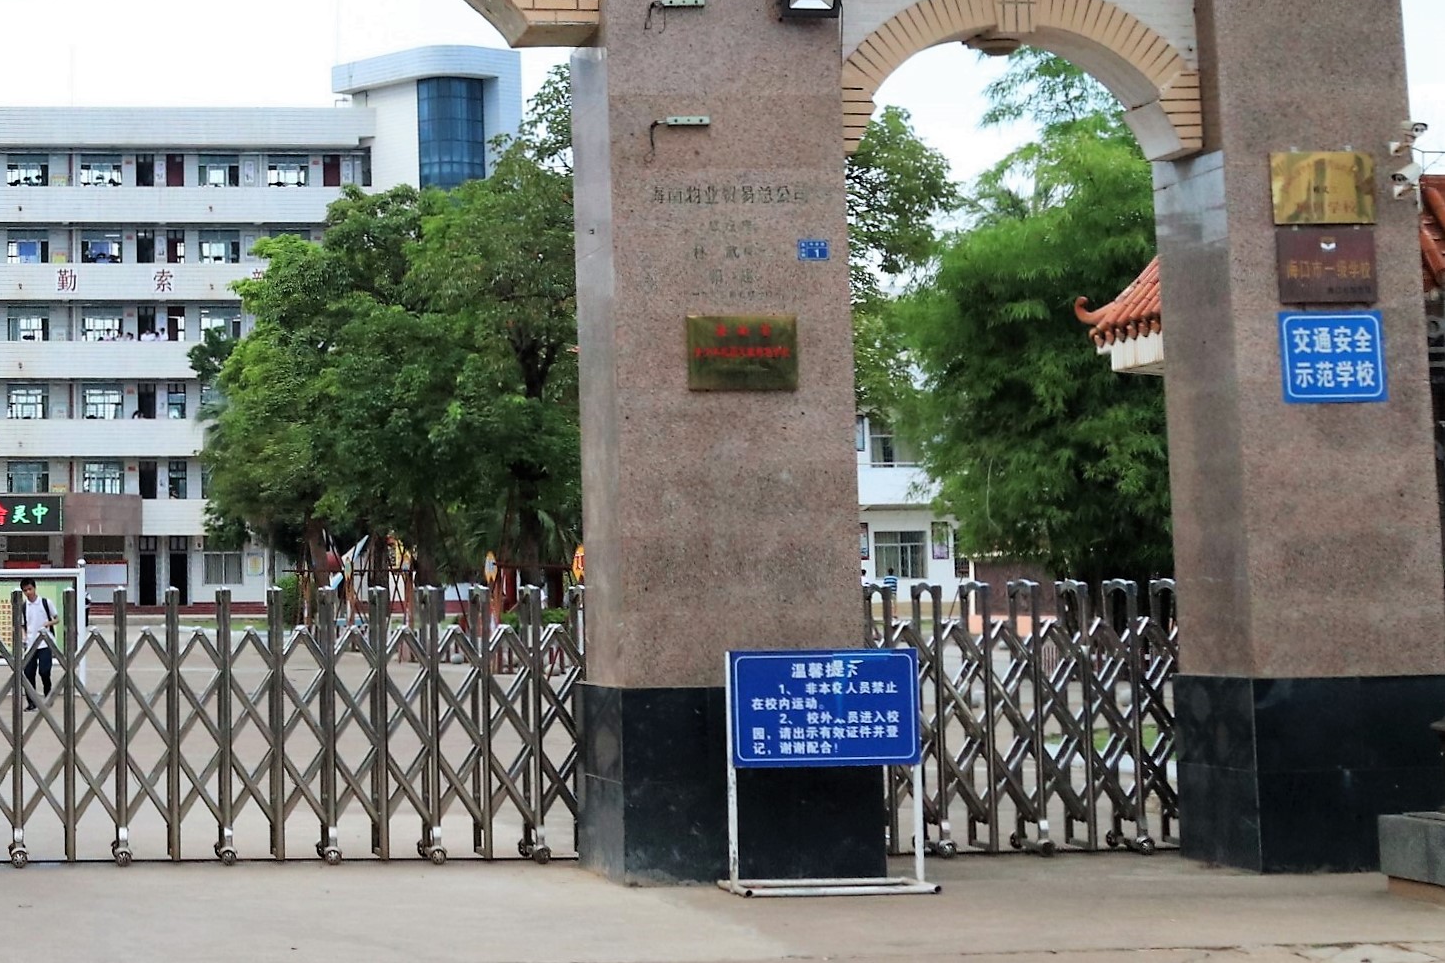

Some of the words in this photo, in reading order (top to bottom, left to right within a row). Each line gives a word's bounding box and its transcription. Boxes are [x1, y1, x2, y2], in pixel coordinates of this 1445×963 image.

[1287, 259, 1371, 279] 海口市一级学校
[1292, 326, 1372, 353] 交通安全
[1295, 361, 1375, 387] 示范学校
